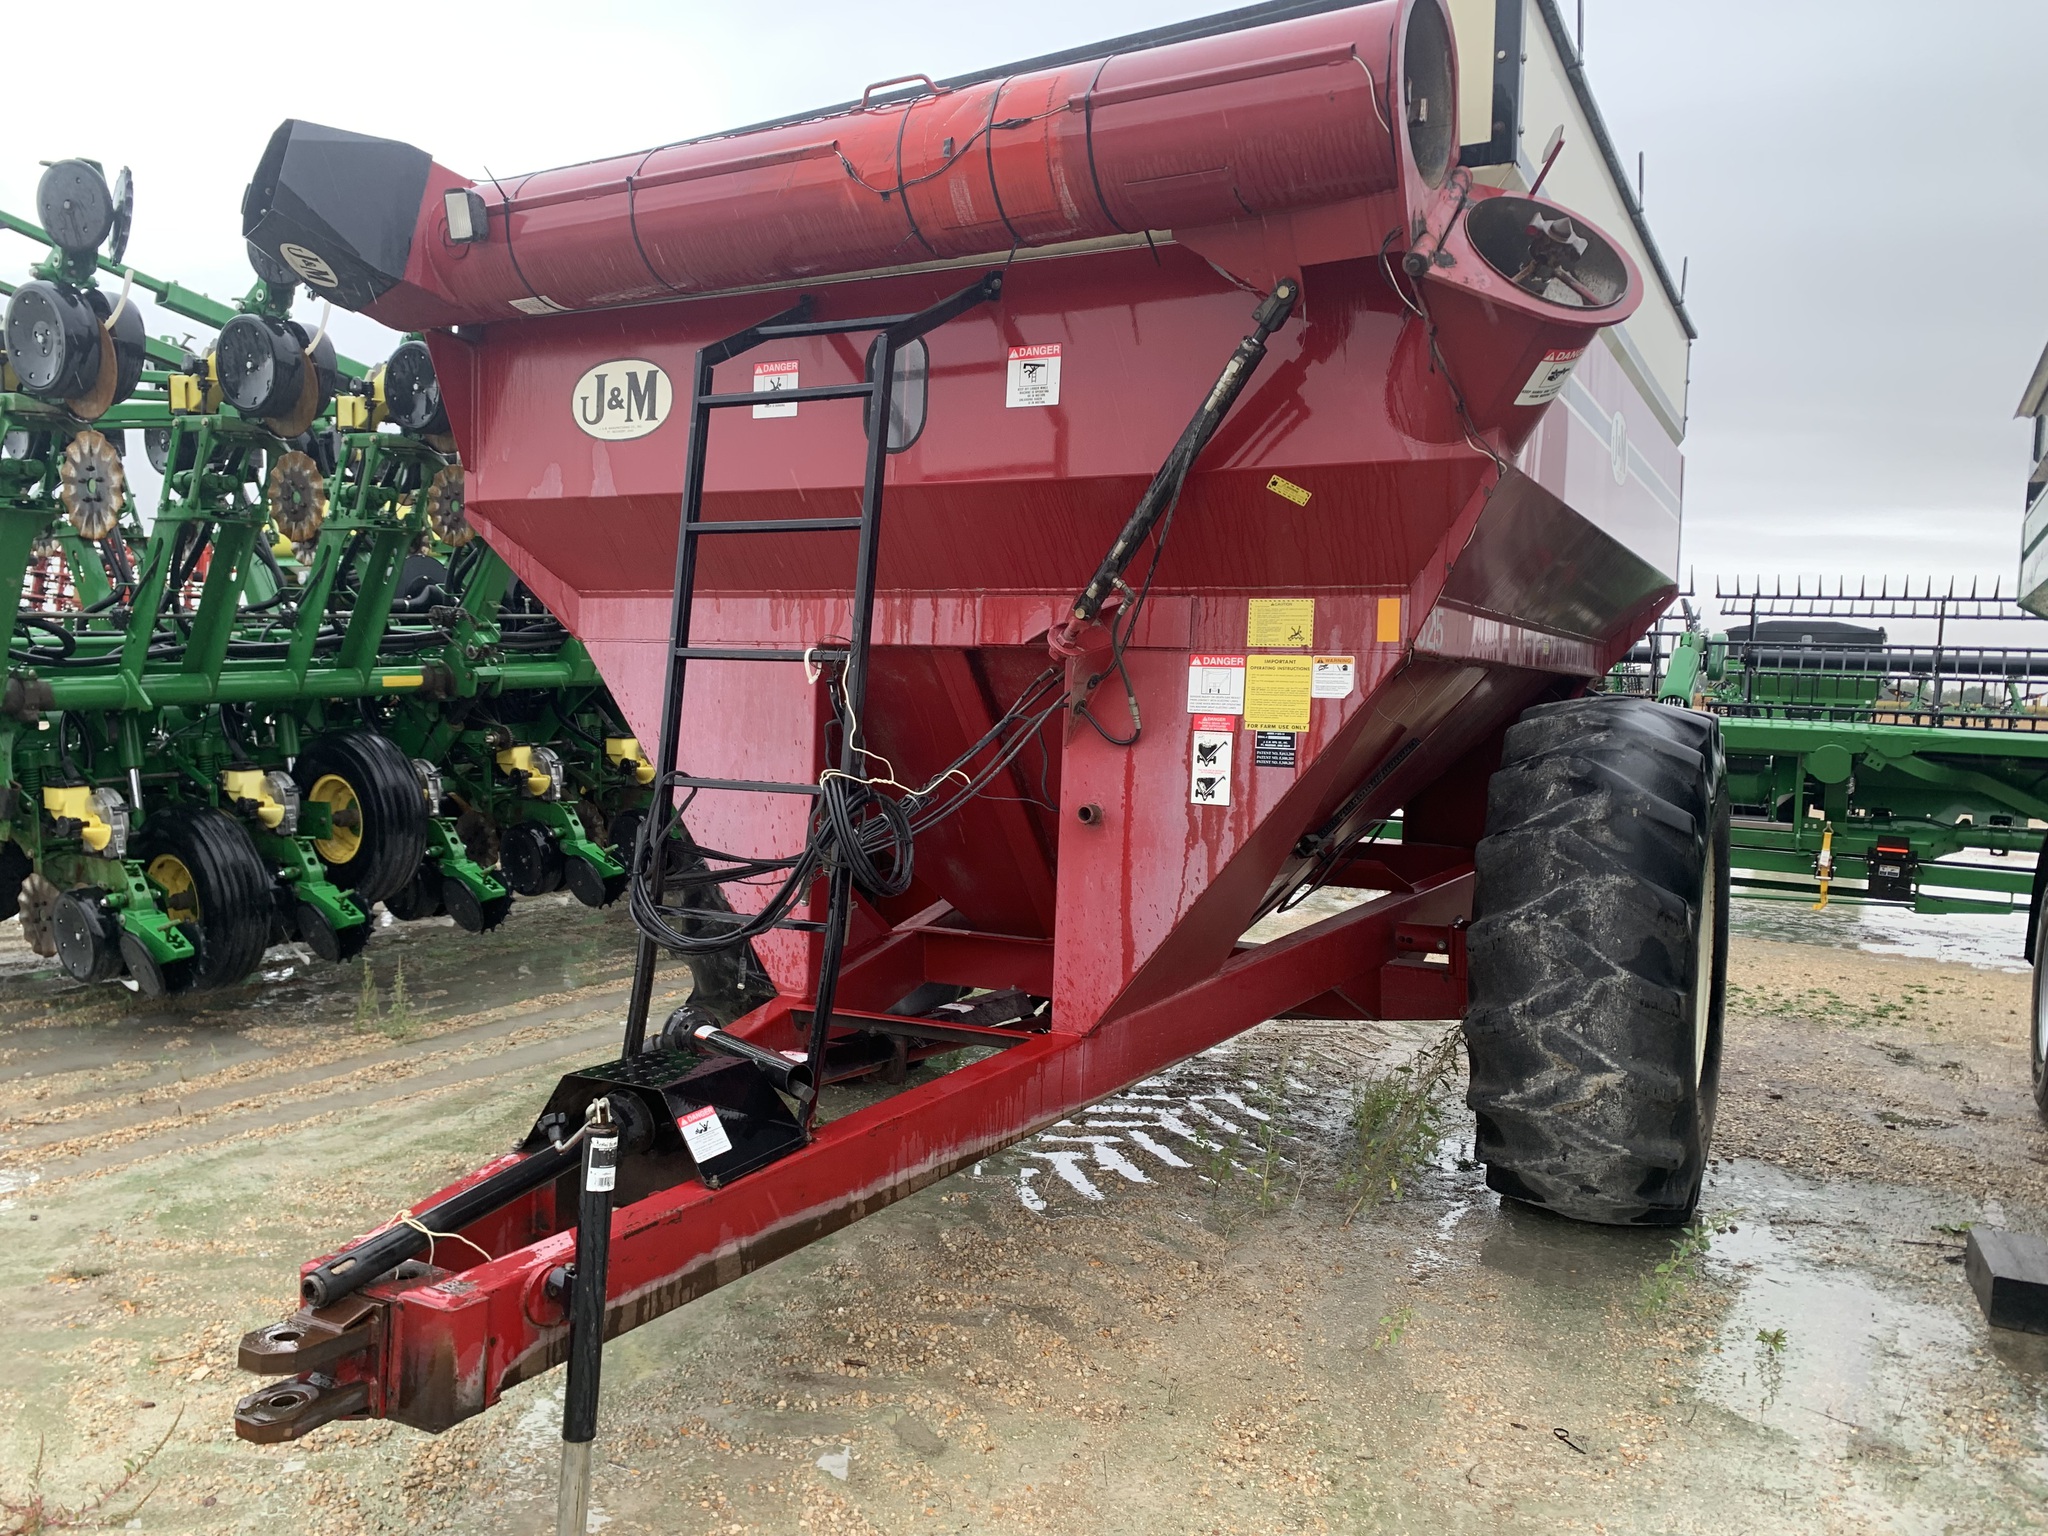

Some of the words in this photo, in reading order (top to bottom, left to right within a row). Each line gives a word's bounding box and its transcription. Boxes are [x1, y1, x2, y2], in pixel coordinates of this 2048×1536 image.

[287, 246, 337, 285] J&M
[1019, 345, 1060, 357] DANGER
[1555, 348, 1584, 360] DANG
[763, 362, 798, 372] DANGER
[580, 369, 660, 426] J&M
[1203, 656, 1244, 666] DANGER
[686, 1108, 714, 1122] DANGER
